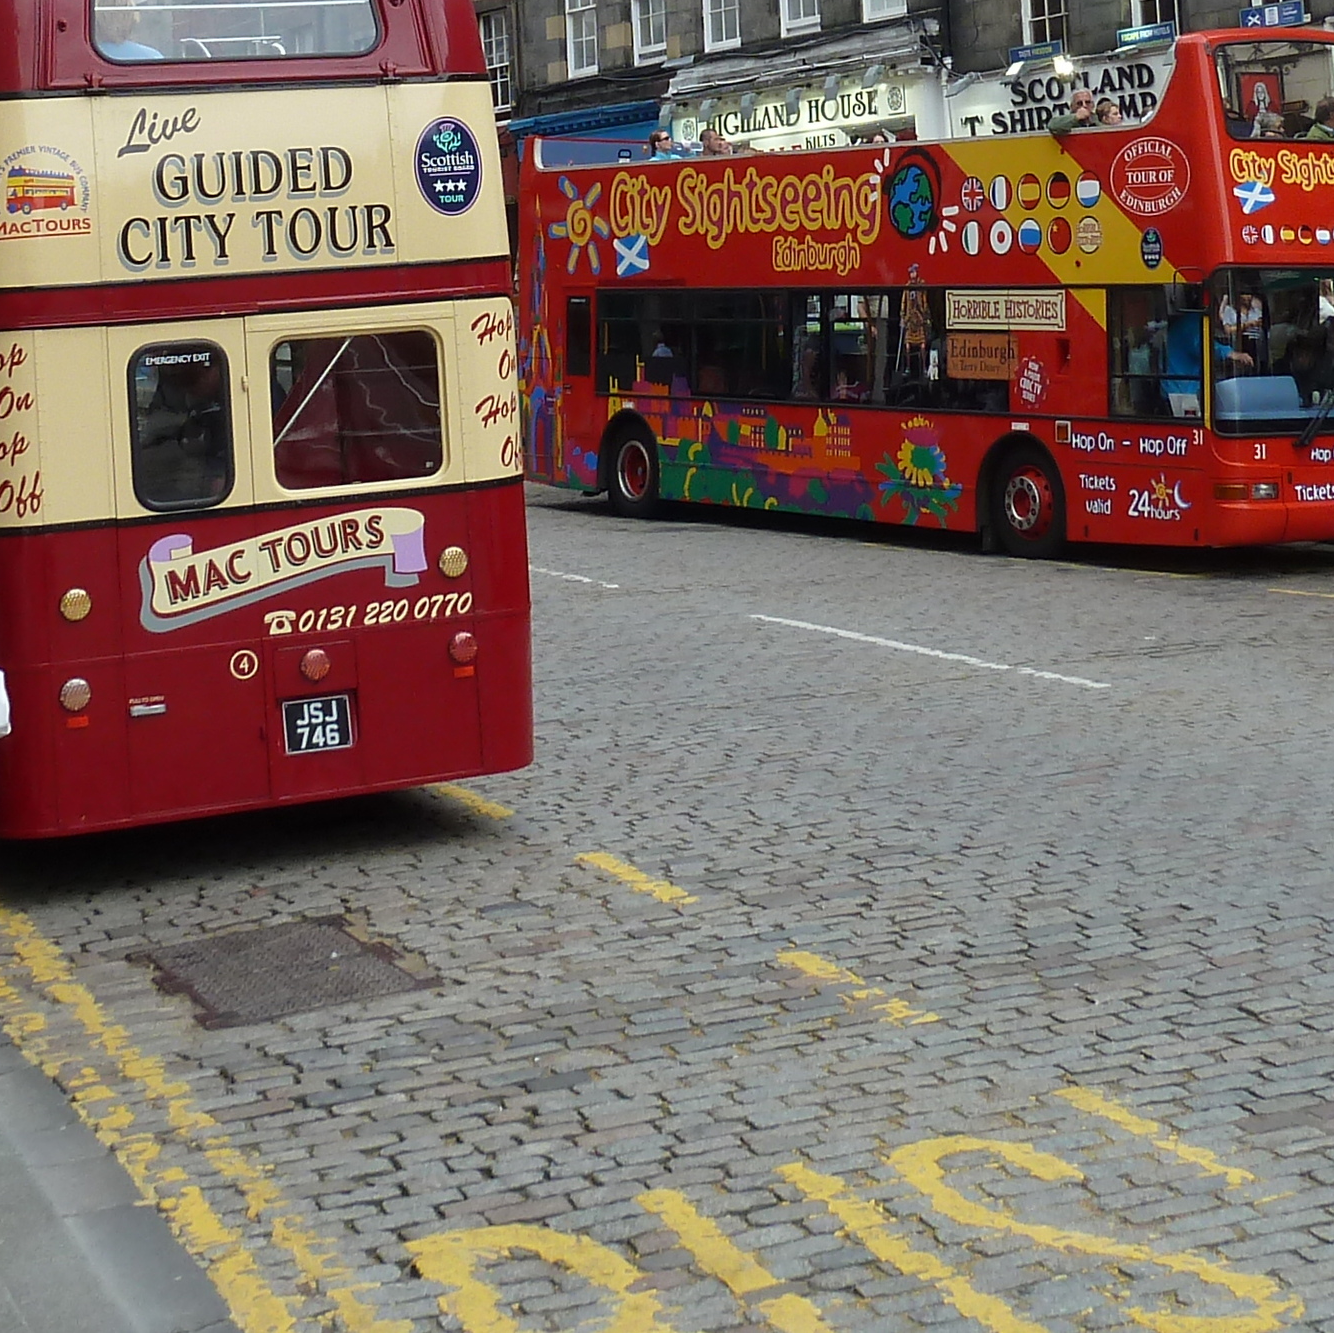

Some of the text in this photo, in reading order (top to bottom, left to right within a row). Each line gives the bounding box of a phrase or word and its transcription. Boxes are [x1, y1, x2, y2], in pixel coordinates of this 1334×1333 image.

[807, 89, 878, 123] HOUSE
[117, 106, 201, 157] Live
[421, 150, 474, 168] Scottish
[1124, 141, 1172, 162] OFFICIAL
[38, 145, 70, 162] VINTAGE
[69, 160, 83, 175] BUS
[79, 175, 91, 213] COMPANY
[154, 146, 352, 203] GUIDED
[1126, 170, 1174, 184] TOUR OF
[1230, 148, 1275, 188] City
[439, 194, 464, 203] TOUR
[610, 165, 881, 249] City Sightseeing
[1120, 187, 1182, 213] EDINBURGH
[117, 203, 395, 268] CITY TOUR
[773, 233, 860, 276] Edinburgh
[145, 352, 210, 366] EMERGENCY EXIT
[949, 337, 1015, 365] Edinburgh
[1072, 433, 1095, 452] Hop
[1098, 432, 1115, 451] On
[1139, 437, 1164, 456] Hop
[1167, 436, 1187, 455] Off
[1192, 429, 1204, 445] 31
[1254, 443, 1266, 460] 31
[1311, 448, 1331, 462] Hop
[1079, 474, 1116, 491] Tickets
[1085, 498, 1111, 515] valid
[1128, 489, 1180, 521] 24 hours
[166, 515, 385, 604] MAC TOURS
[298, 592, 473, 633] 0131 220 0770
[239, 656, 249, 673] 4
[297, 700, 338, 727] JSJ
[297, 724, 340, 749] 746
